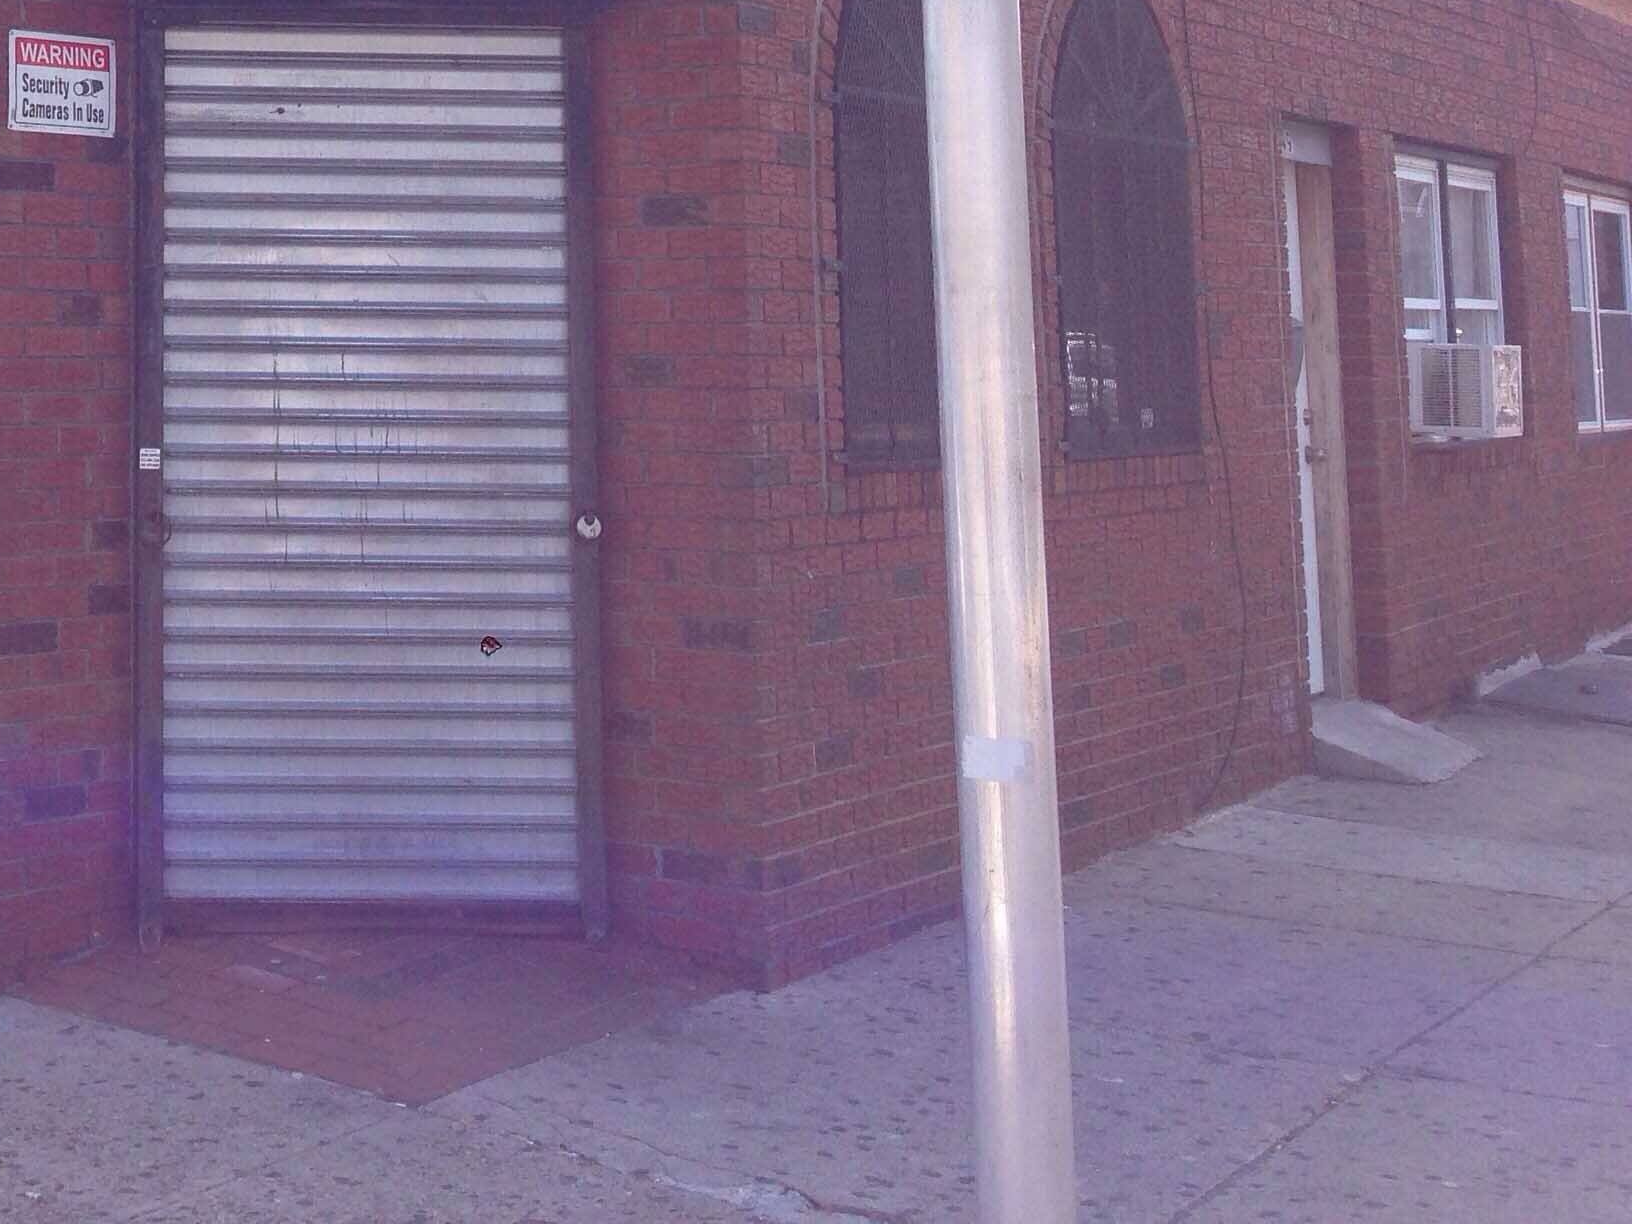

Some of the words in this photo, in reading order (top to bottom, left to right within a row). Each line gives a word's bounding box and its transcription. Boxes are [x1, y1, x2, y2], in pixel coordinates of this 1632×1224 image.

[20, 42, 105, 68] WARNING
[22, 73, 70, 99] Security
[22, 98, 69, 120] Cameras
[73, 101, 83, 121] In
[86, 103, 104, 124] Use
